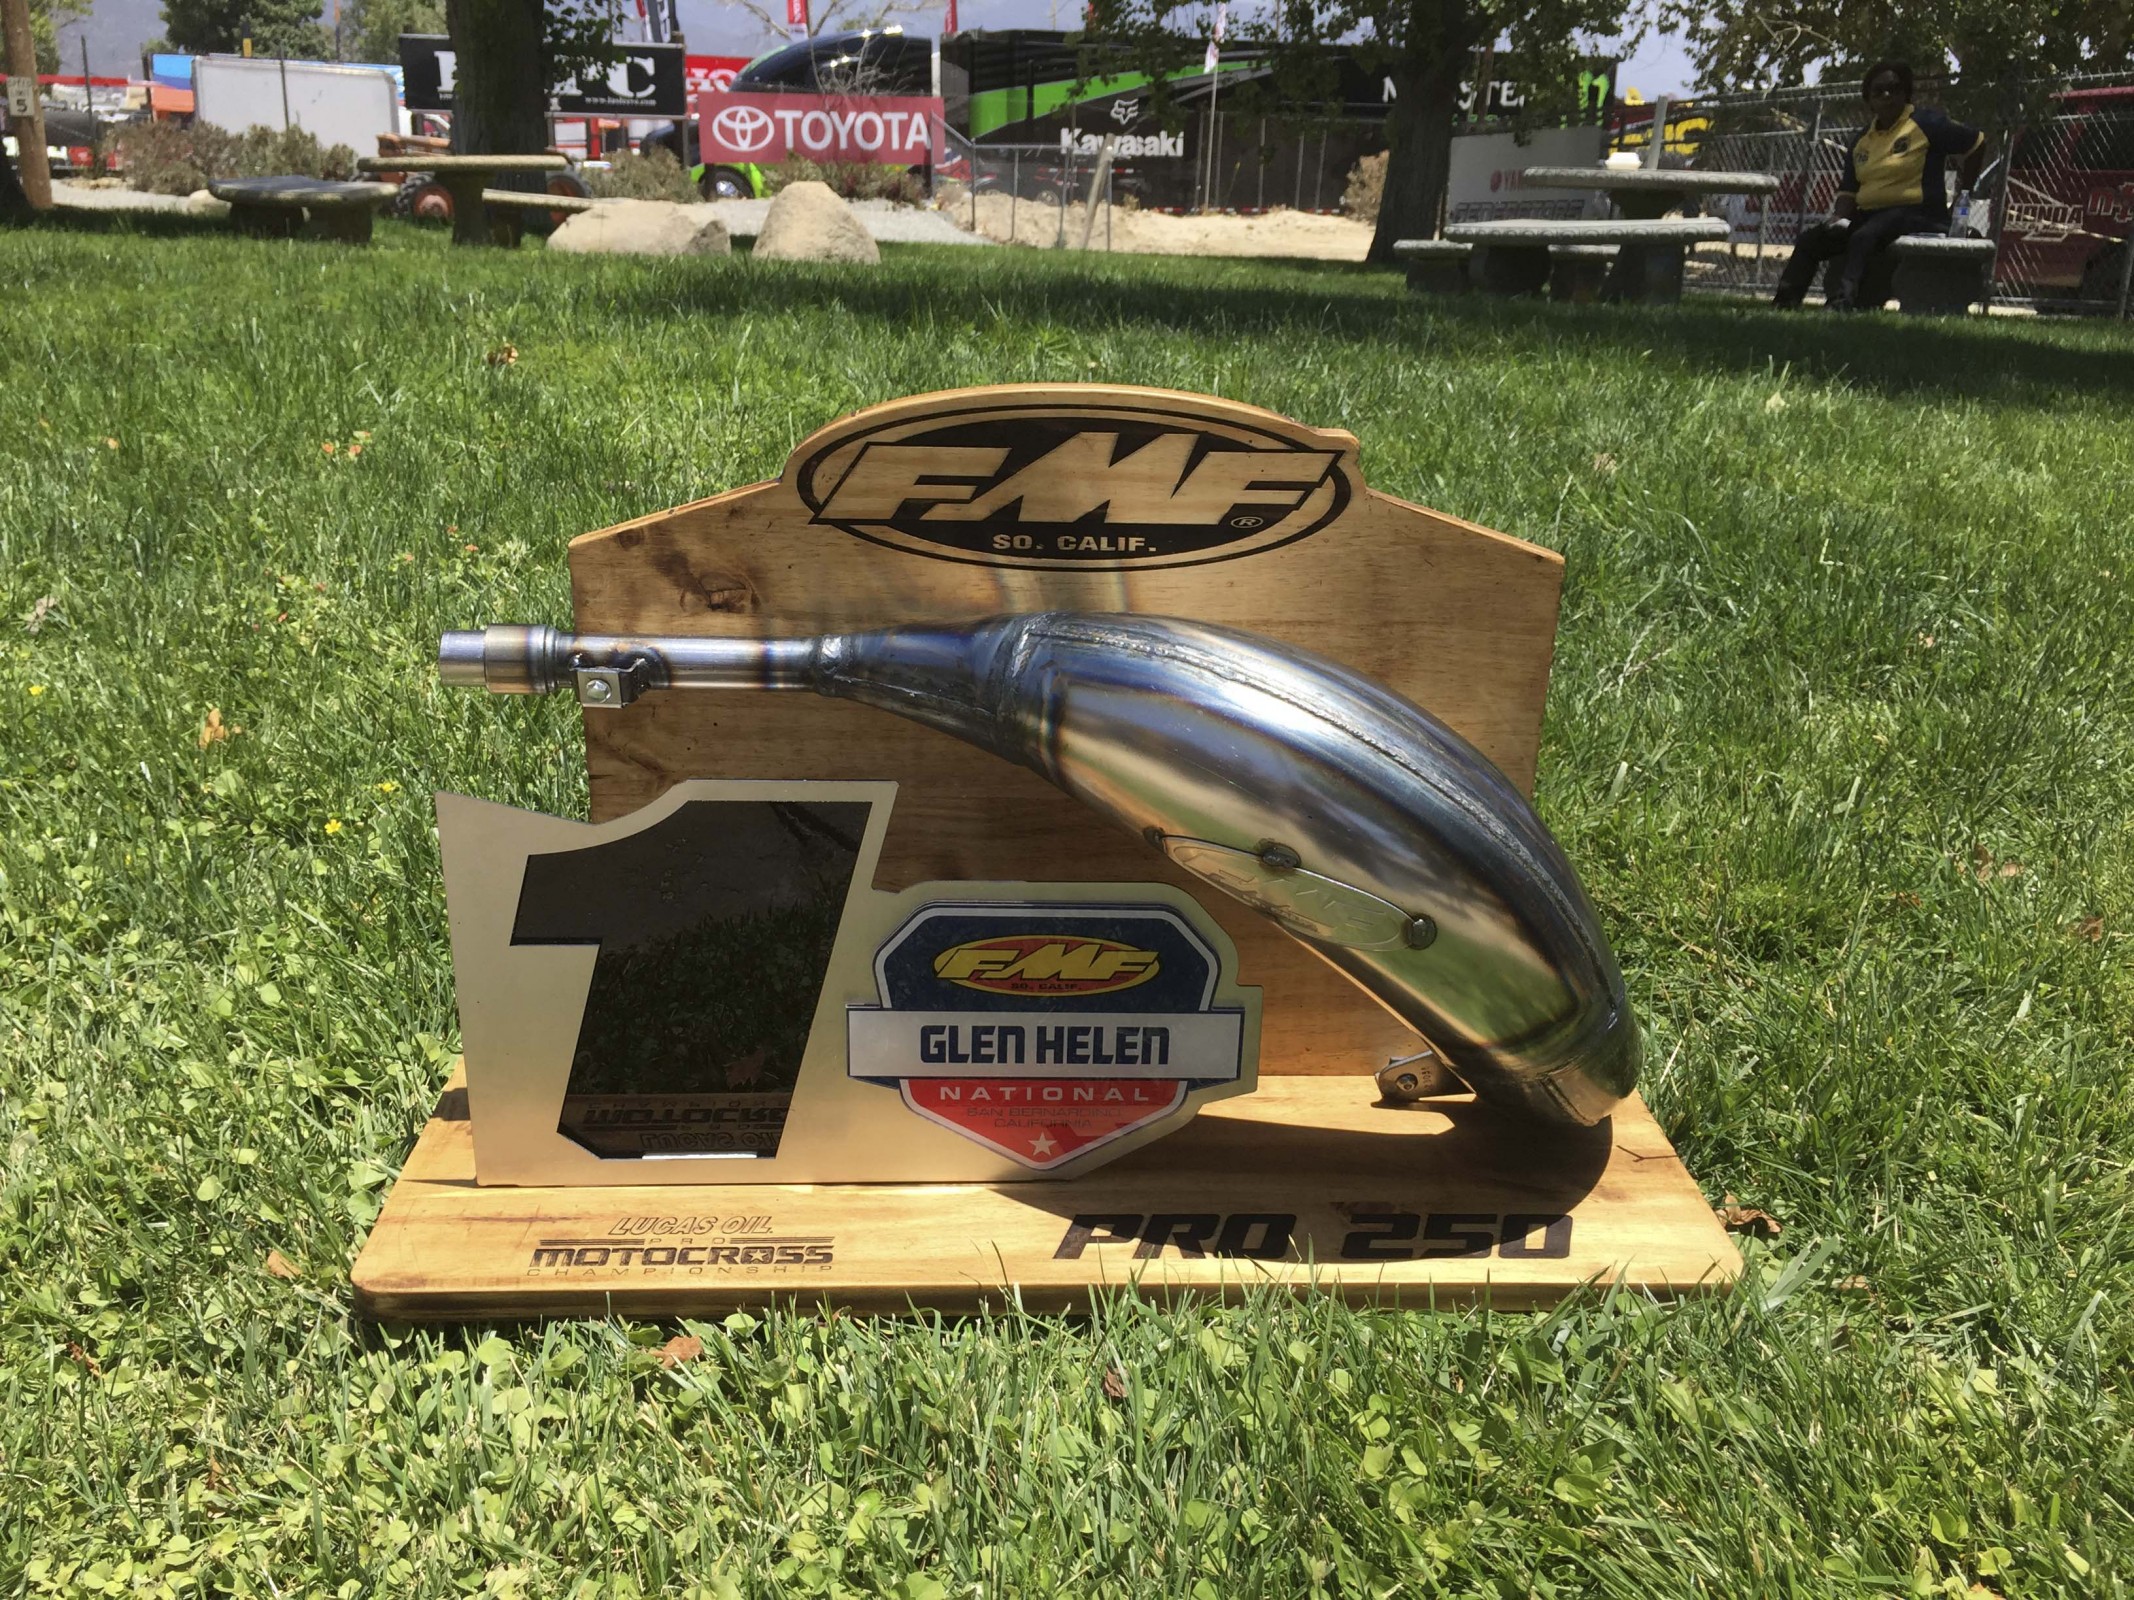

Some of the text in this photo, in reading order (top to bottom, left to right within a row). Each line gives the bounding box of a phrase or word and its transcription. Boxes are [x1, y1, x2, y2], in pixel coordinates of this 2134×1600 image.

[16, 99, 28, 113] 5
[774, 110, 932, 151] TOYOTA
[815, 431, 1338, 526] FMF
[993, 533, 1158, 553] SO. CALIF.
[936, 944, 1160, 981] FMF
[920, 1025, 1170, 1066] GLEN HELEN
[940, 1086, 1149, 1101] NATIONAL
[967, 1108, 1121, 1118] SAN BERNARDINO
[994, 1119, 1092, 1129] CALIFORNIA
[608, 1217, 718, 1236] LUCAS
[649, 1237, 726, 1245] PRO
[1053, 1213, 1574, 1260] PRO 250
[529, 1245, 835, 1268] MOTOCROSS
[526, 1265, 833, 1277] CHAMPIONSHIP
